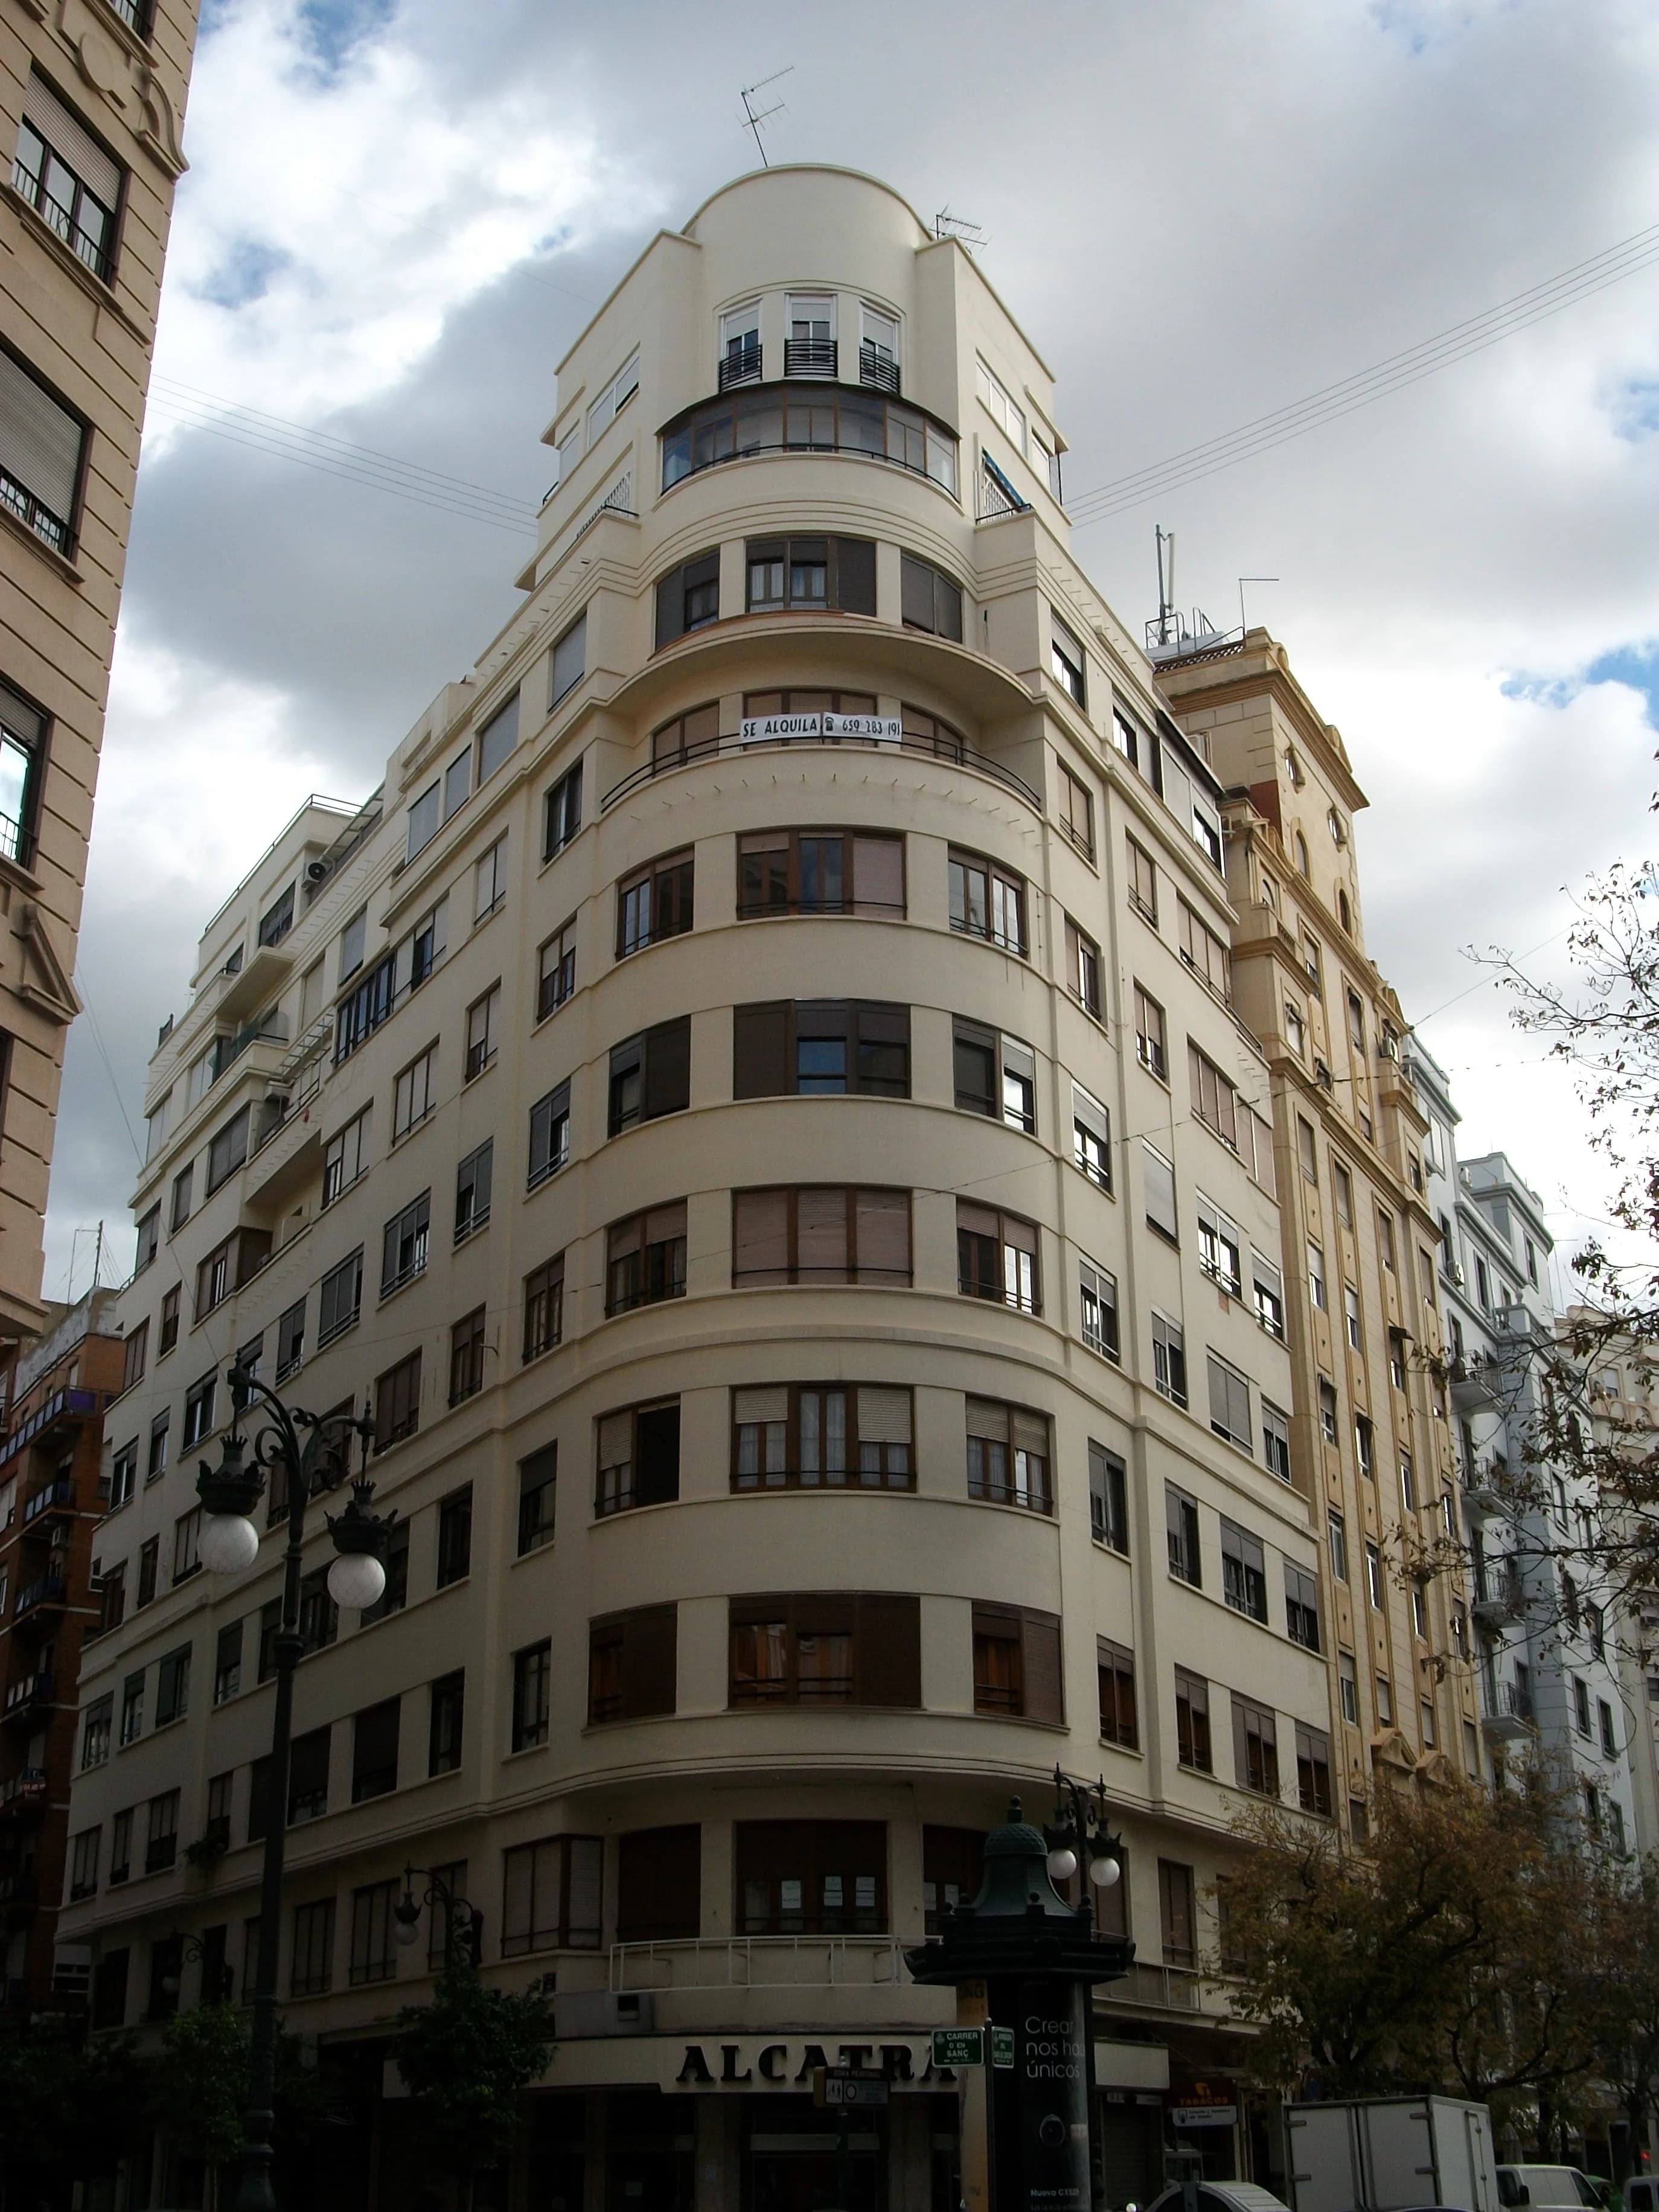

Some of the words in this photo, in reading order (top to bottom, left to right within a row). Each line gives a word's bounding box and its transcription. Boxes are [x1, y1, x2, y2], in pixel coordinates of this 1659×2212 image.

[743, 722, 757, 737] SE
[765, 717, 817, 734] ALQUILA
[843, 720, 860, 732] 659
[866, 720, 883, 735] 283
[888, 723, 900, 736] 191
[1025, 2016, 1074, 2035] Crear
[946, 2031, 978, 2041] CARRER
[946, 2049, 970, 2058] SANÇ
[1026, 2042, 1059, 2057] nos
[1026, 2059, 1080, 2079] únicos
[1178, 2095, 1229, 2106] TABACOS
